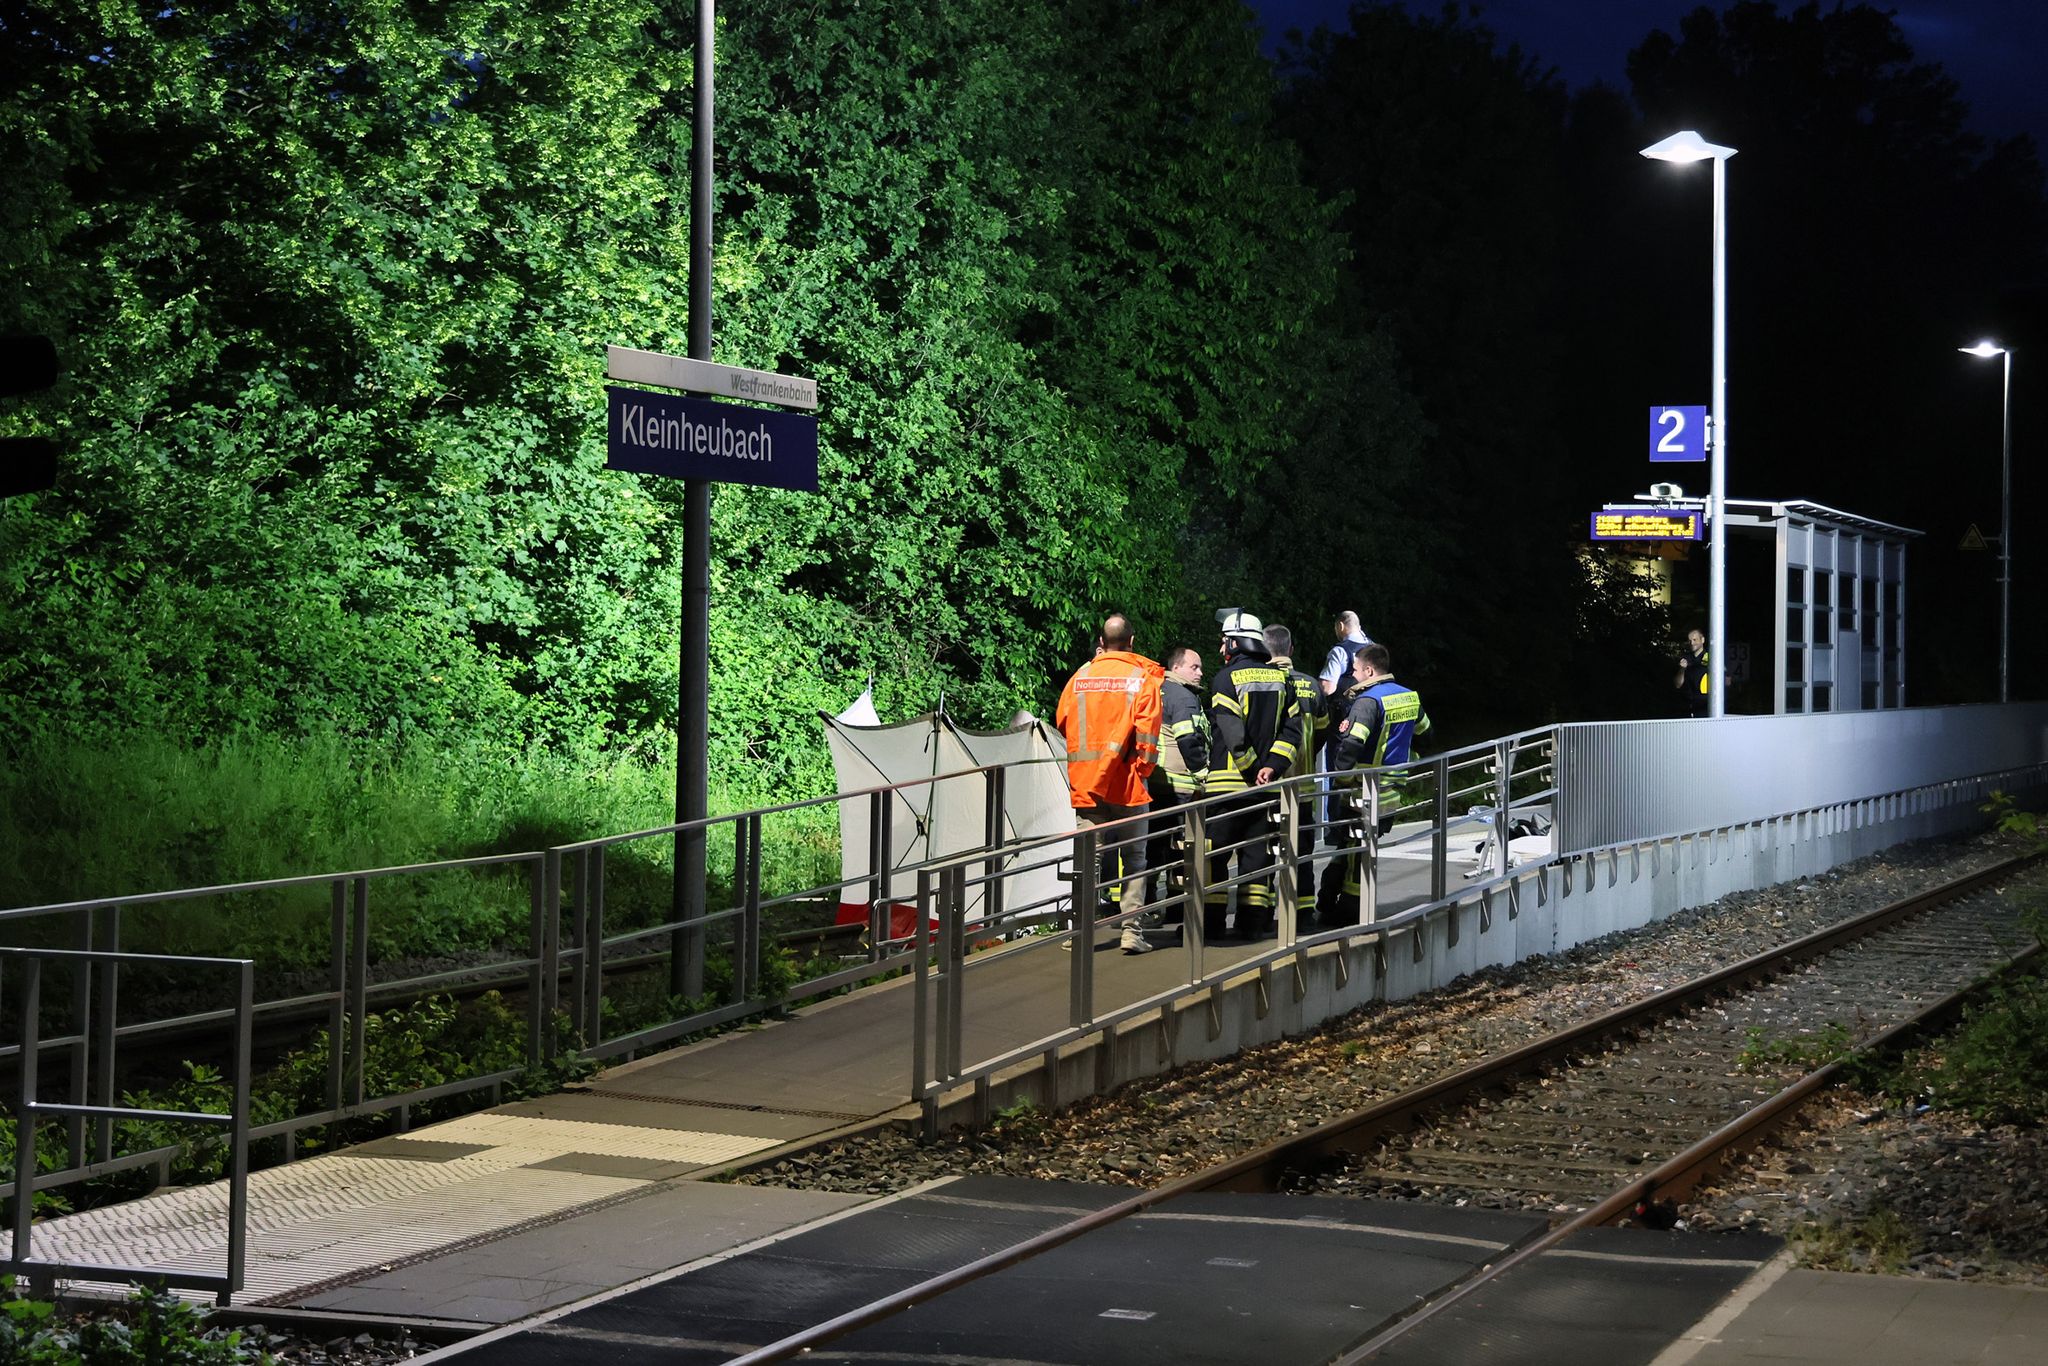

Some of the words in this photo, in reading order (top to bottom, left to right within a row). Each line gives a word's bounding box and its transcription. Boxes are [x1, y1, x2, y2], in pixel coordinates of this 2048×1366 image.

[731, 374, 812, 402] Westfrankenbahn
[622, 404, 772, 462] Kleinheubach
[1657, 409, 1685, 452] 2
